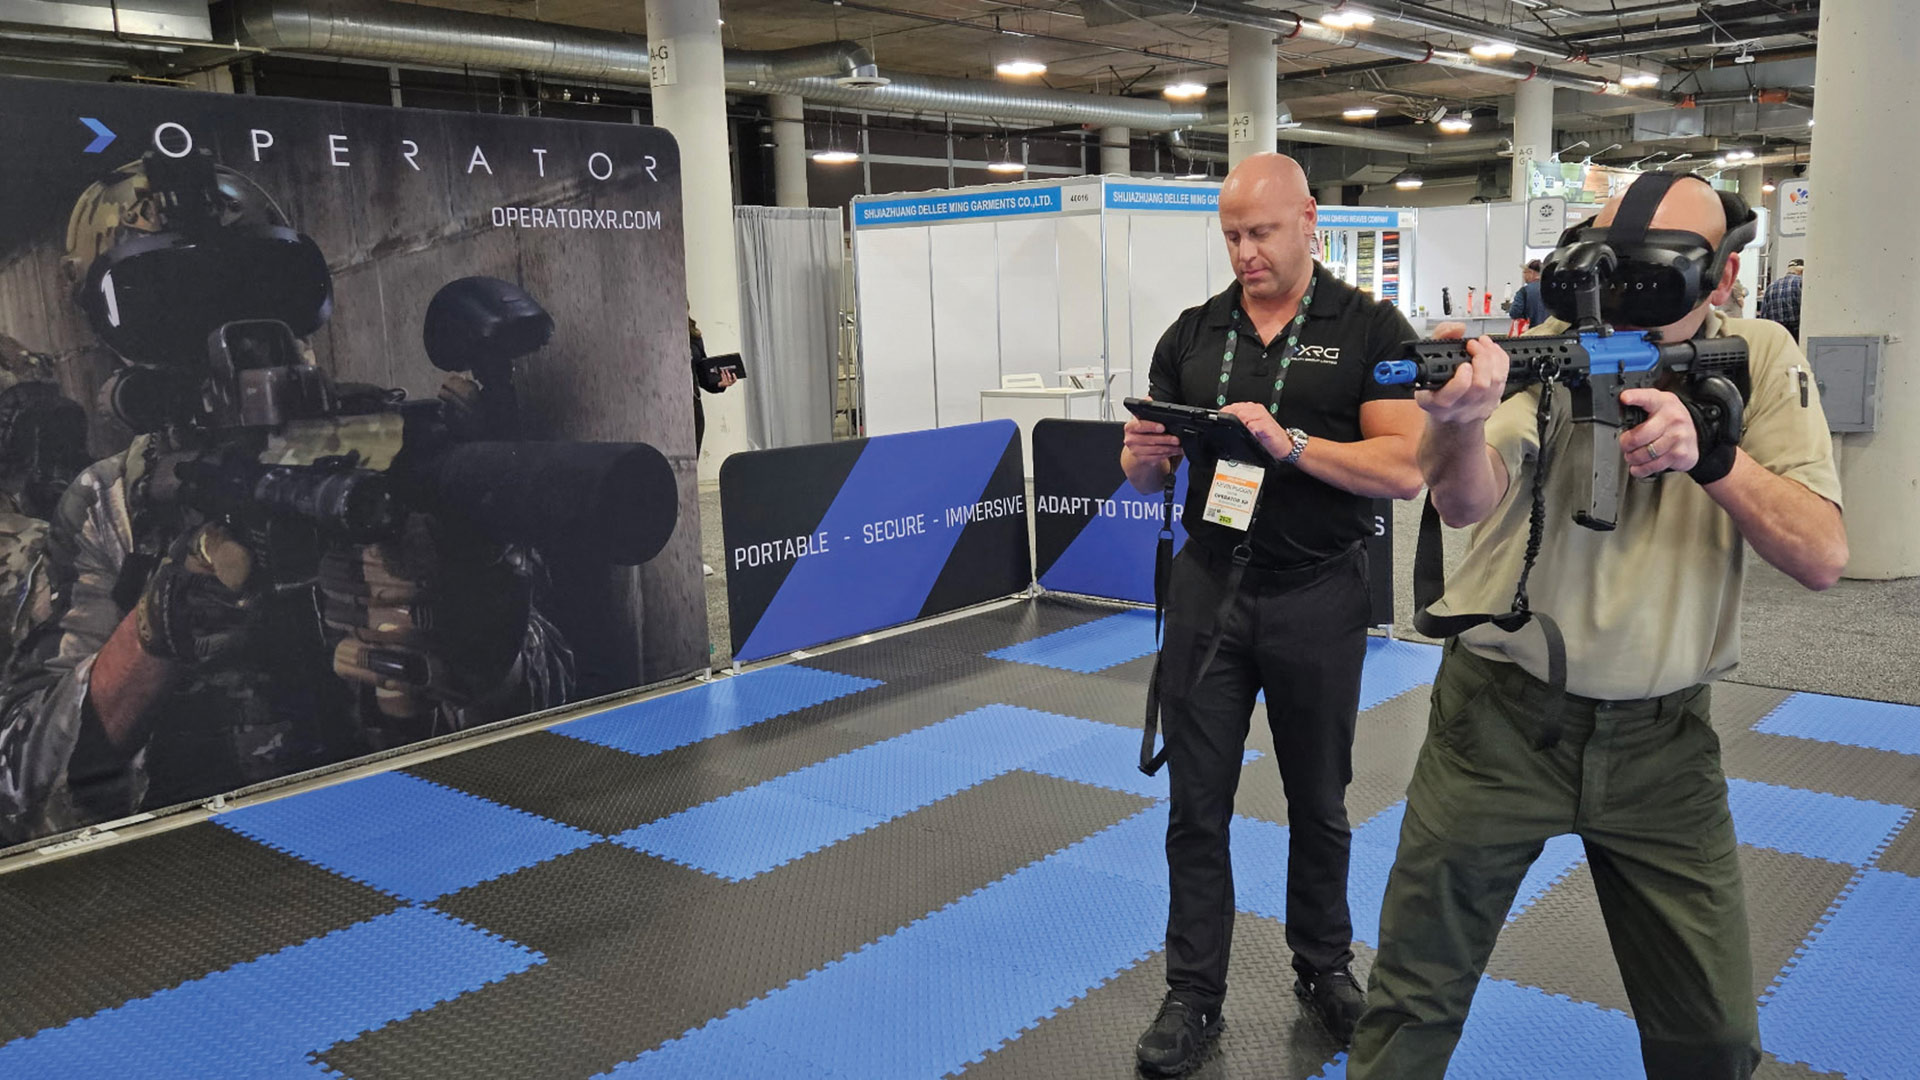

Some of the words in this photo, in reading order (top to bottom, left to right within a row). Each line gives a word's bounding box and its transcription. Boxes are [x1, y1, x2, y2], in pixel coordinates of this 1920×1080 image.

[651, 45, 668, 60] A-G
[652, 66, 658, 80] E
[661, 65, 665, 78] 1
[1233, 116, 1248, 126] A-G
[1234, 130, 1240, 138] F
[1243, 129, 1247, 138] 1
[154, 121, 658, 182] OPERATOR
[1519, 147, 1533, 155] A-G
[1113, 191, 1162, 203] SHIJIAZHUANG
[1164, 193, 1189, 204] DELLEE
[1190, 194, 1206, 205] MING
[864, 205, 917, 219] SHIJIAZHUANG
[919, 203, 948, 216] DELLEE
[949, 201, 969, 213] MING
[970, 195, 1016, 211] GARMENTS
[1018, 194, 1054, 208] CO.,LTD.
[491, 206, 661, 230] OPERATORXR.COM
[1298, 344, 1340, 359] XRG
[1037, 495, 1090, 516] ADAPT
[1095, 499, 1116, 517] TO
[735, 532, 829, 570] PORTABLE
[863, 514, 926, 545] SECURE
[945, 495, 1024, 528] IMMERSIVE
